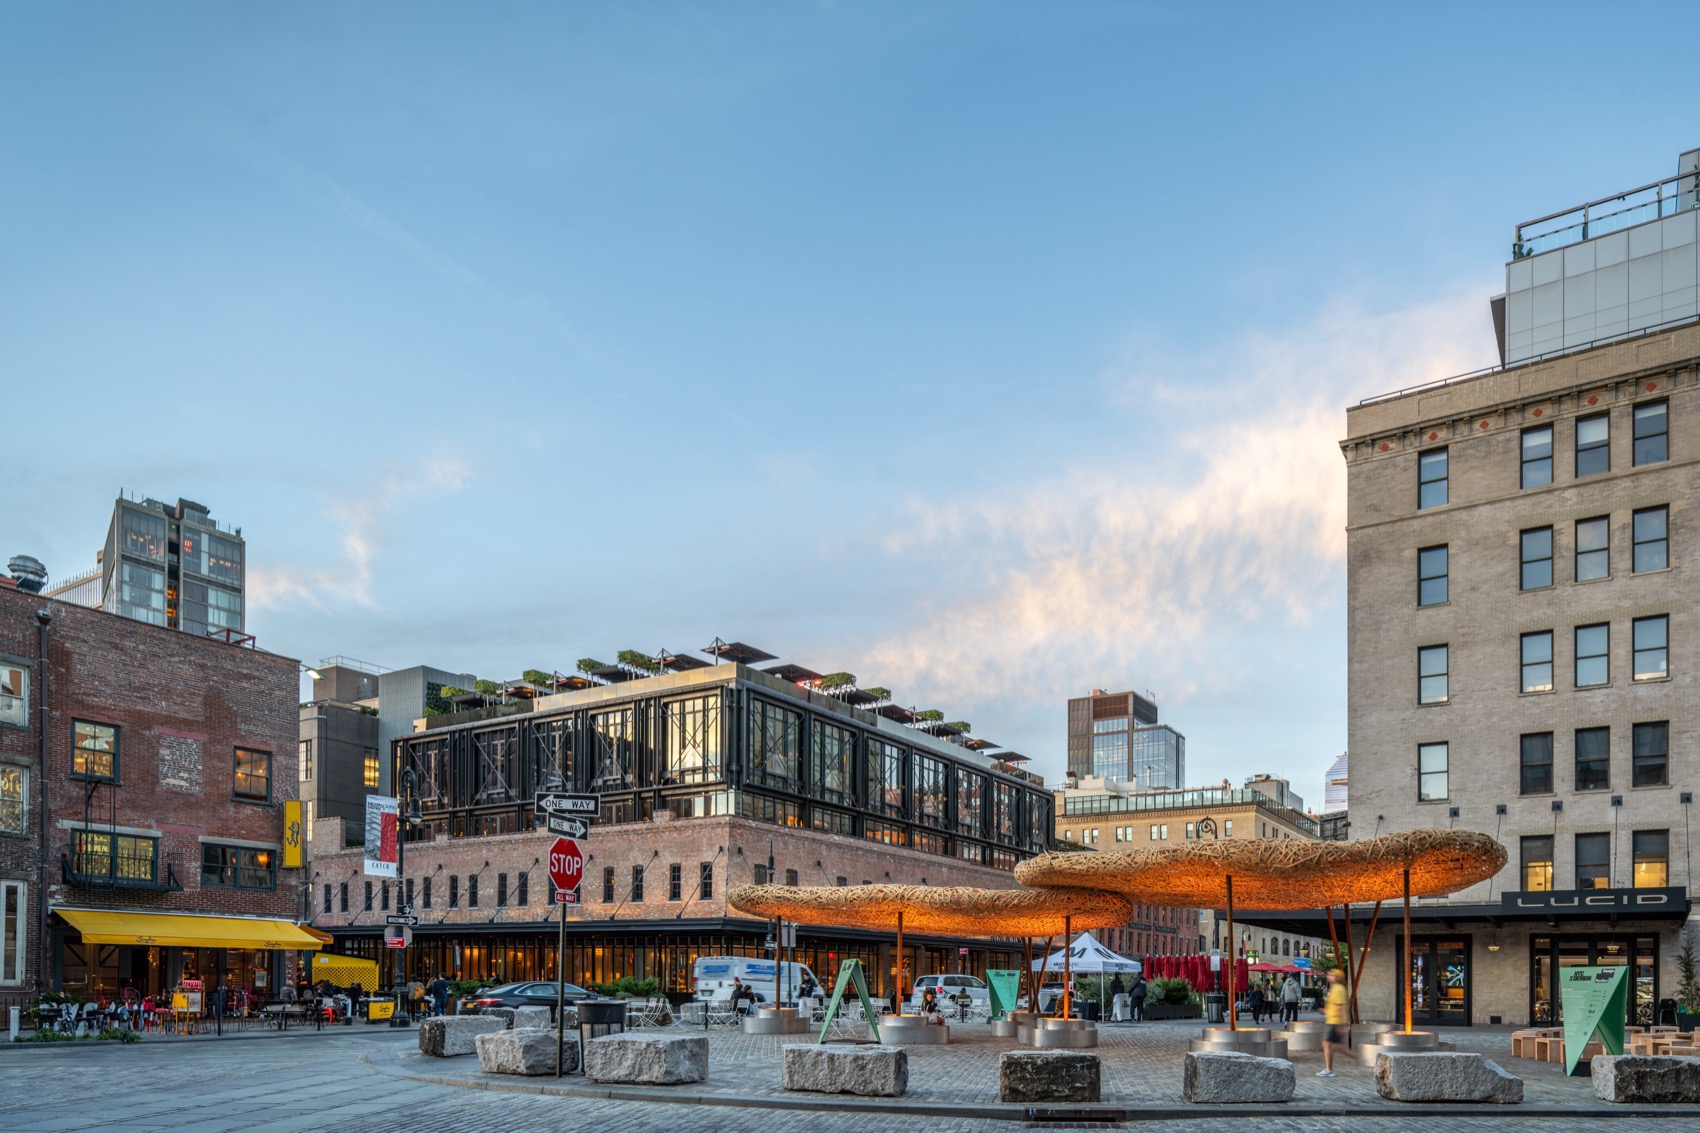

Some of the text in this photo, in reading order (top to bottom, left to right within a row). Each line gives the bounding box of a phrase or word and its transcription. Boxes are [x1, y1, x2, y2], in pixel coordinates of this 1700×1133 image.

[545, 799, 591, 809] ONE WAY
[553, 819, 582, 834] ONE WAY
[550, 852, 582, 876] STOP
[556, 893, 575, 902] ALL WAY
[1516, 894, 1668, 907] LUCID
